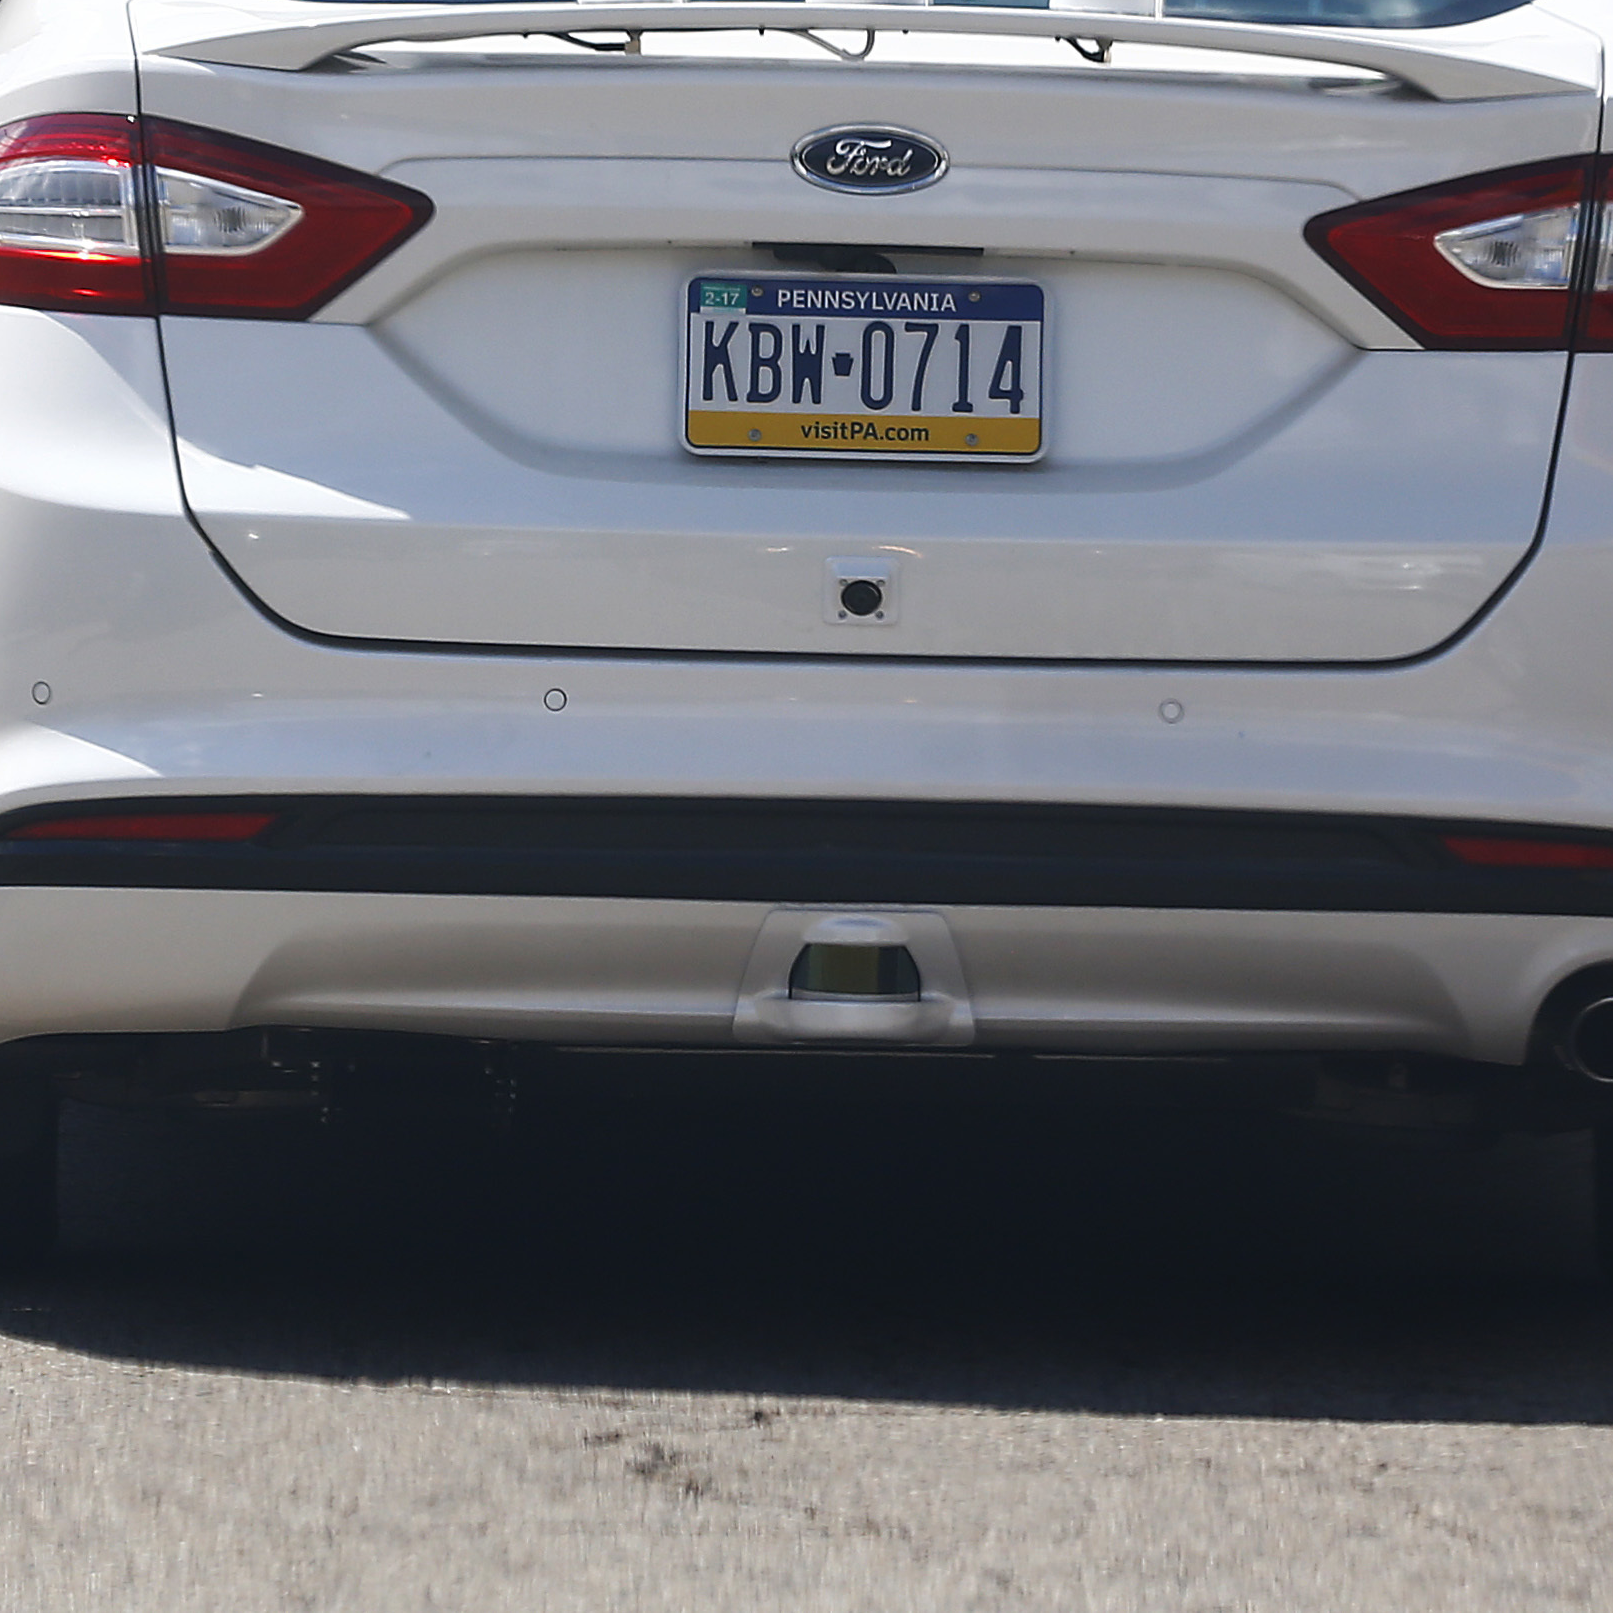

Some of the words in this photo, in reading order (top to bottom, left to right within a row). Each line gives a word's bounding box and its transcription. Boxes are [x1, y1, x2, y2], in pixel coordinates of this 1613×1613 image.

[826, 138, 913, 176] Ford
[705, 291, 740, 306] 2-17
[777, 289, 957, 313] PENNSYLVANIA
[800, 421, 930, 442] visitPA.com
